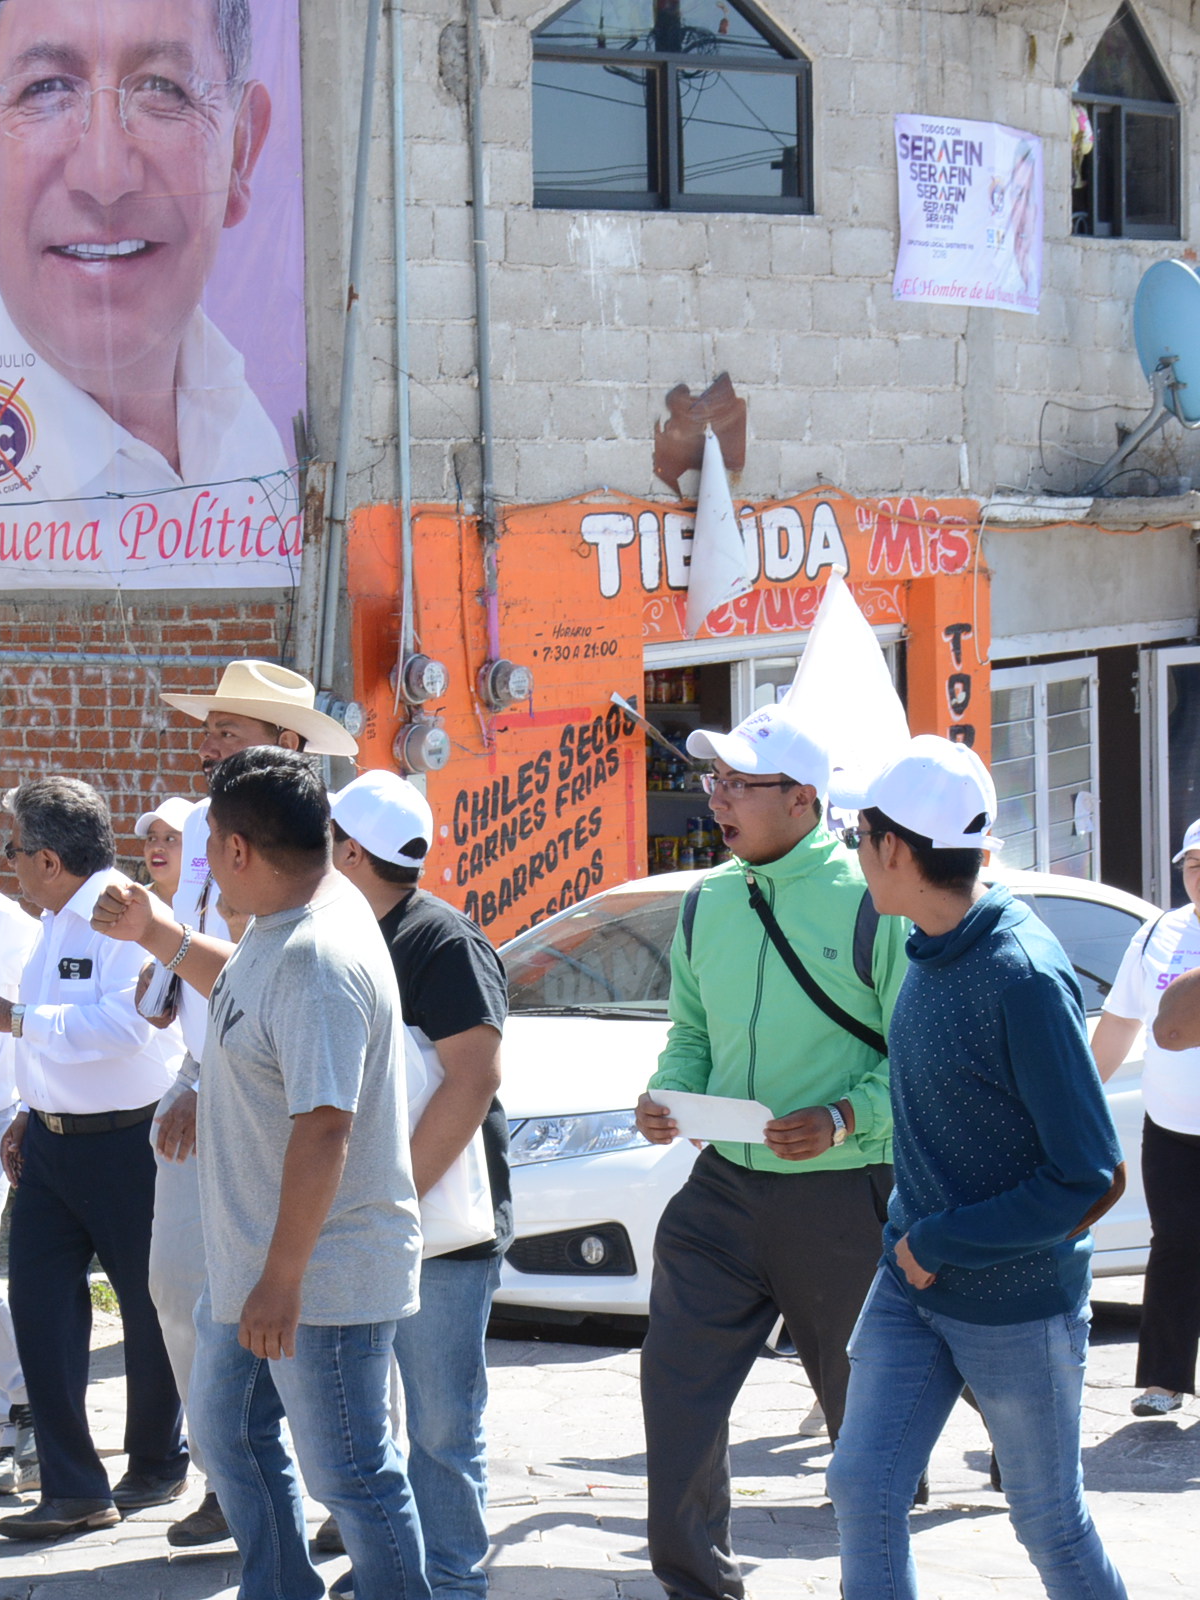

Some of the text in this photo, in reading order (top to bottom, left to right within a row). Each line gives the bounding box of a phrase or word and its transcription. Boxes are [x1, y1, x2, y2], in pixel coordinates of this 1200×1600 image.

[921, 123, 961, 137] TODOS CON
[899, 133, 983, 167] SERAFIN
[910, 162, 972, 187] SERAFIN
[916, 182, 966, 203] SERAFIN
[922, 201, 959, 215] SERAFIN
[919, 279, 969, 299] Hombre
[969, 281, 982, 299] de
[984, 282, 996, 301] la
[119, 490, 304, 561] Política
[543, 640, 618, 662] 7:30 A 21:00
[453, 694, 638, 846] CHILES SECOS
[456, 747, 620, 887] CARNES FRIAS
[464, 806, 602, 928] ABARROTES
